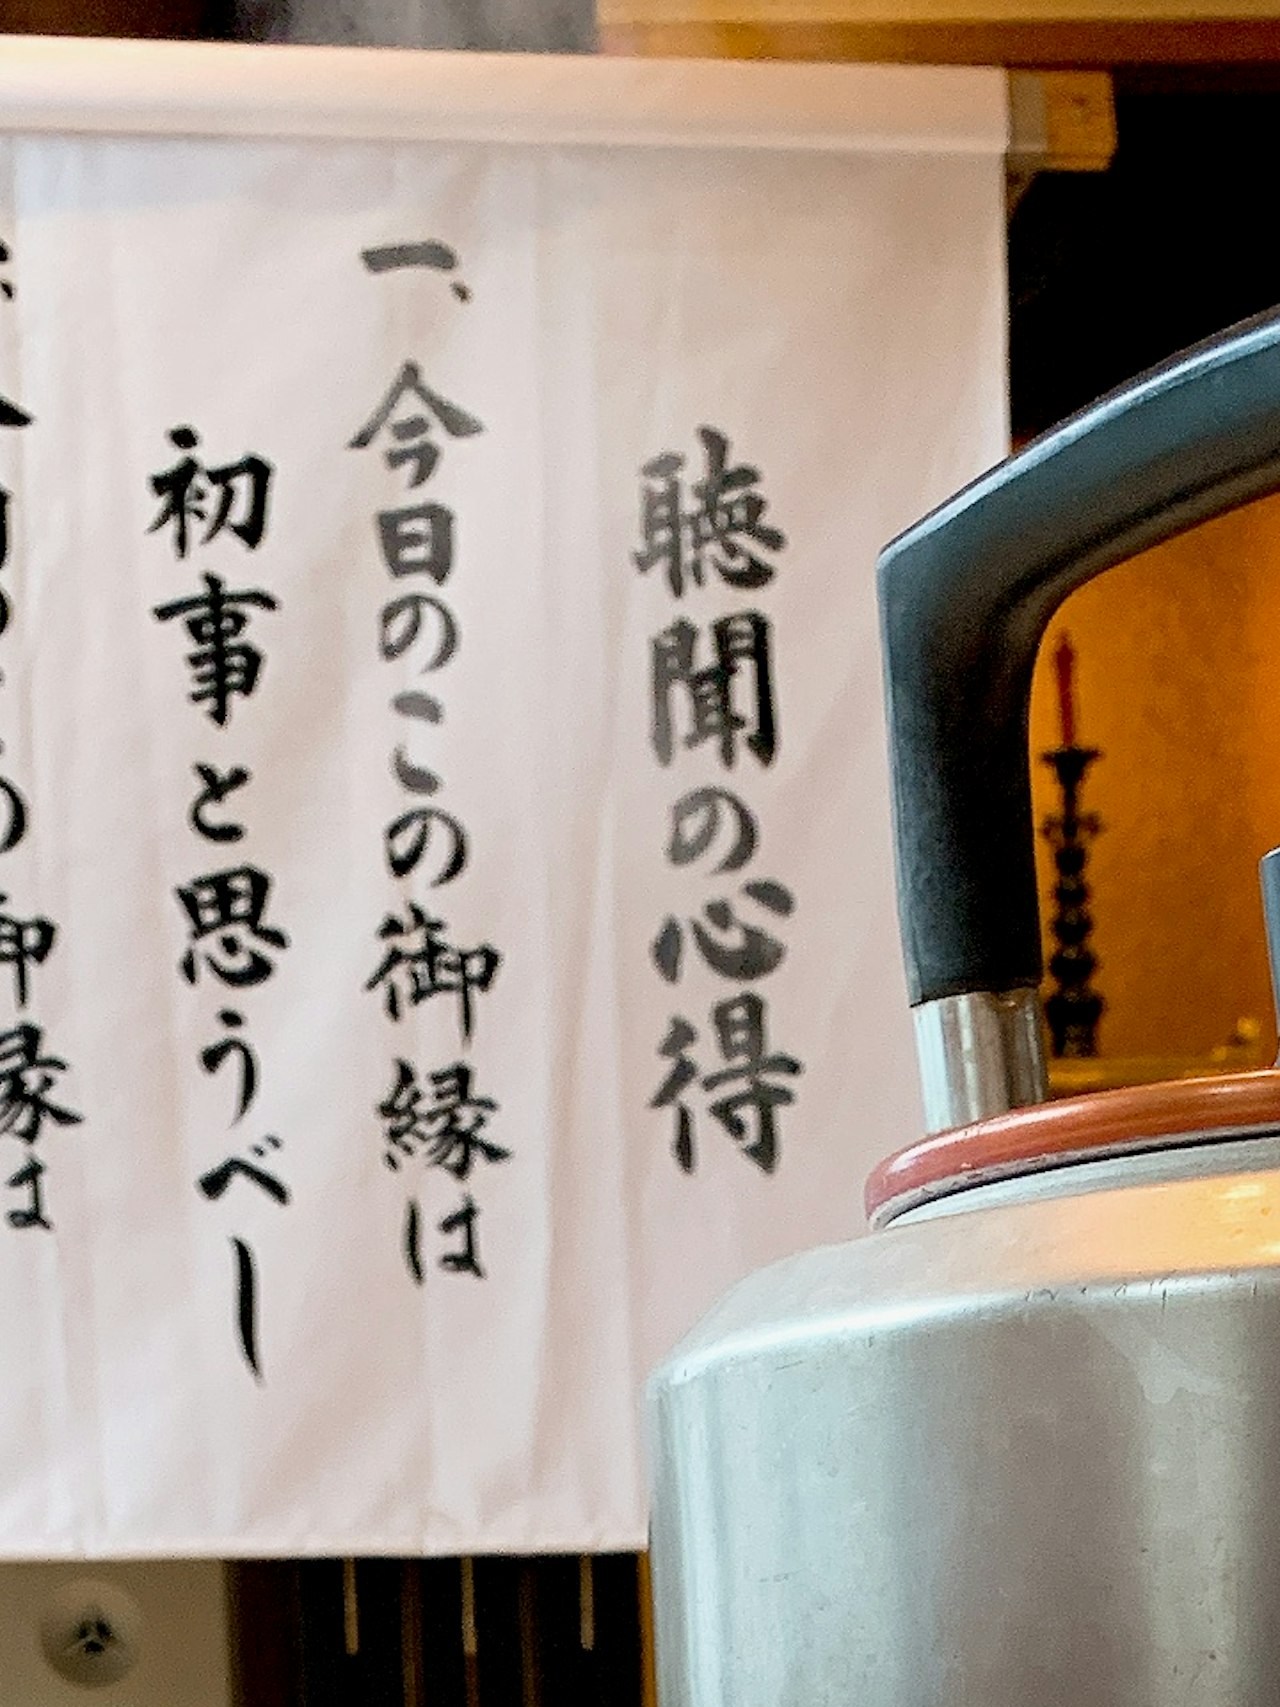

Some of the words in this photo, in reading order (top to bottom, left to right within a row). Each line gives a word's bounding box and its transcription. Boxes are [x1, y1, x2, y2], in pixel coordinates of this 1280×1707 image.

[631, 426, 804, 1178] 聴聞の心得
